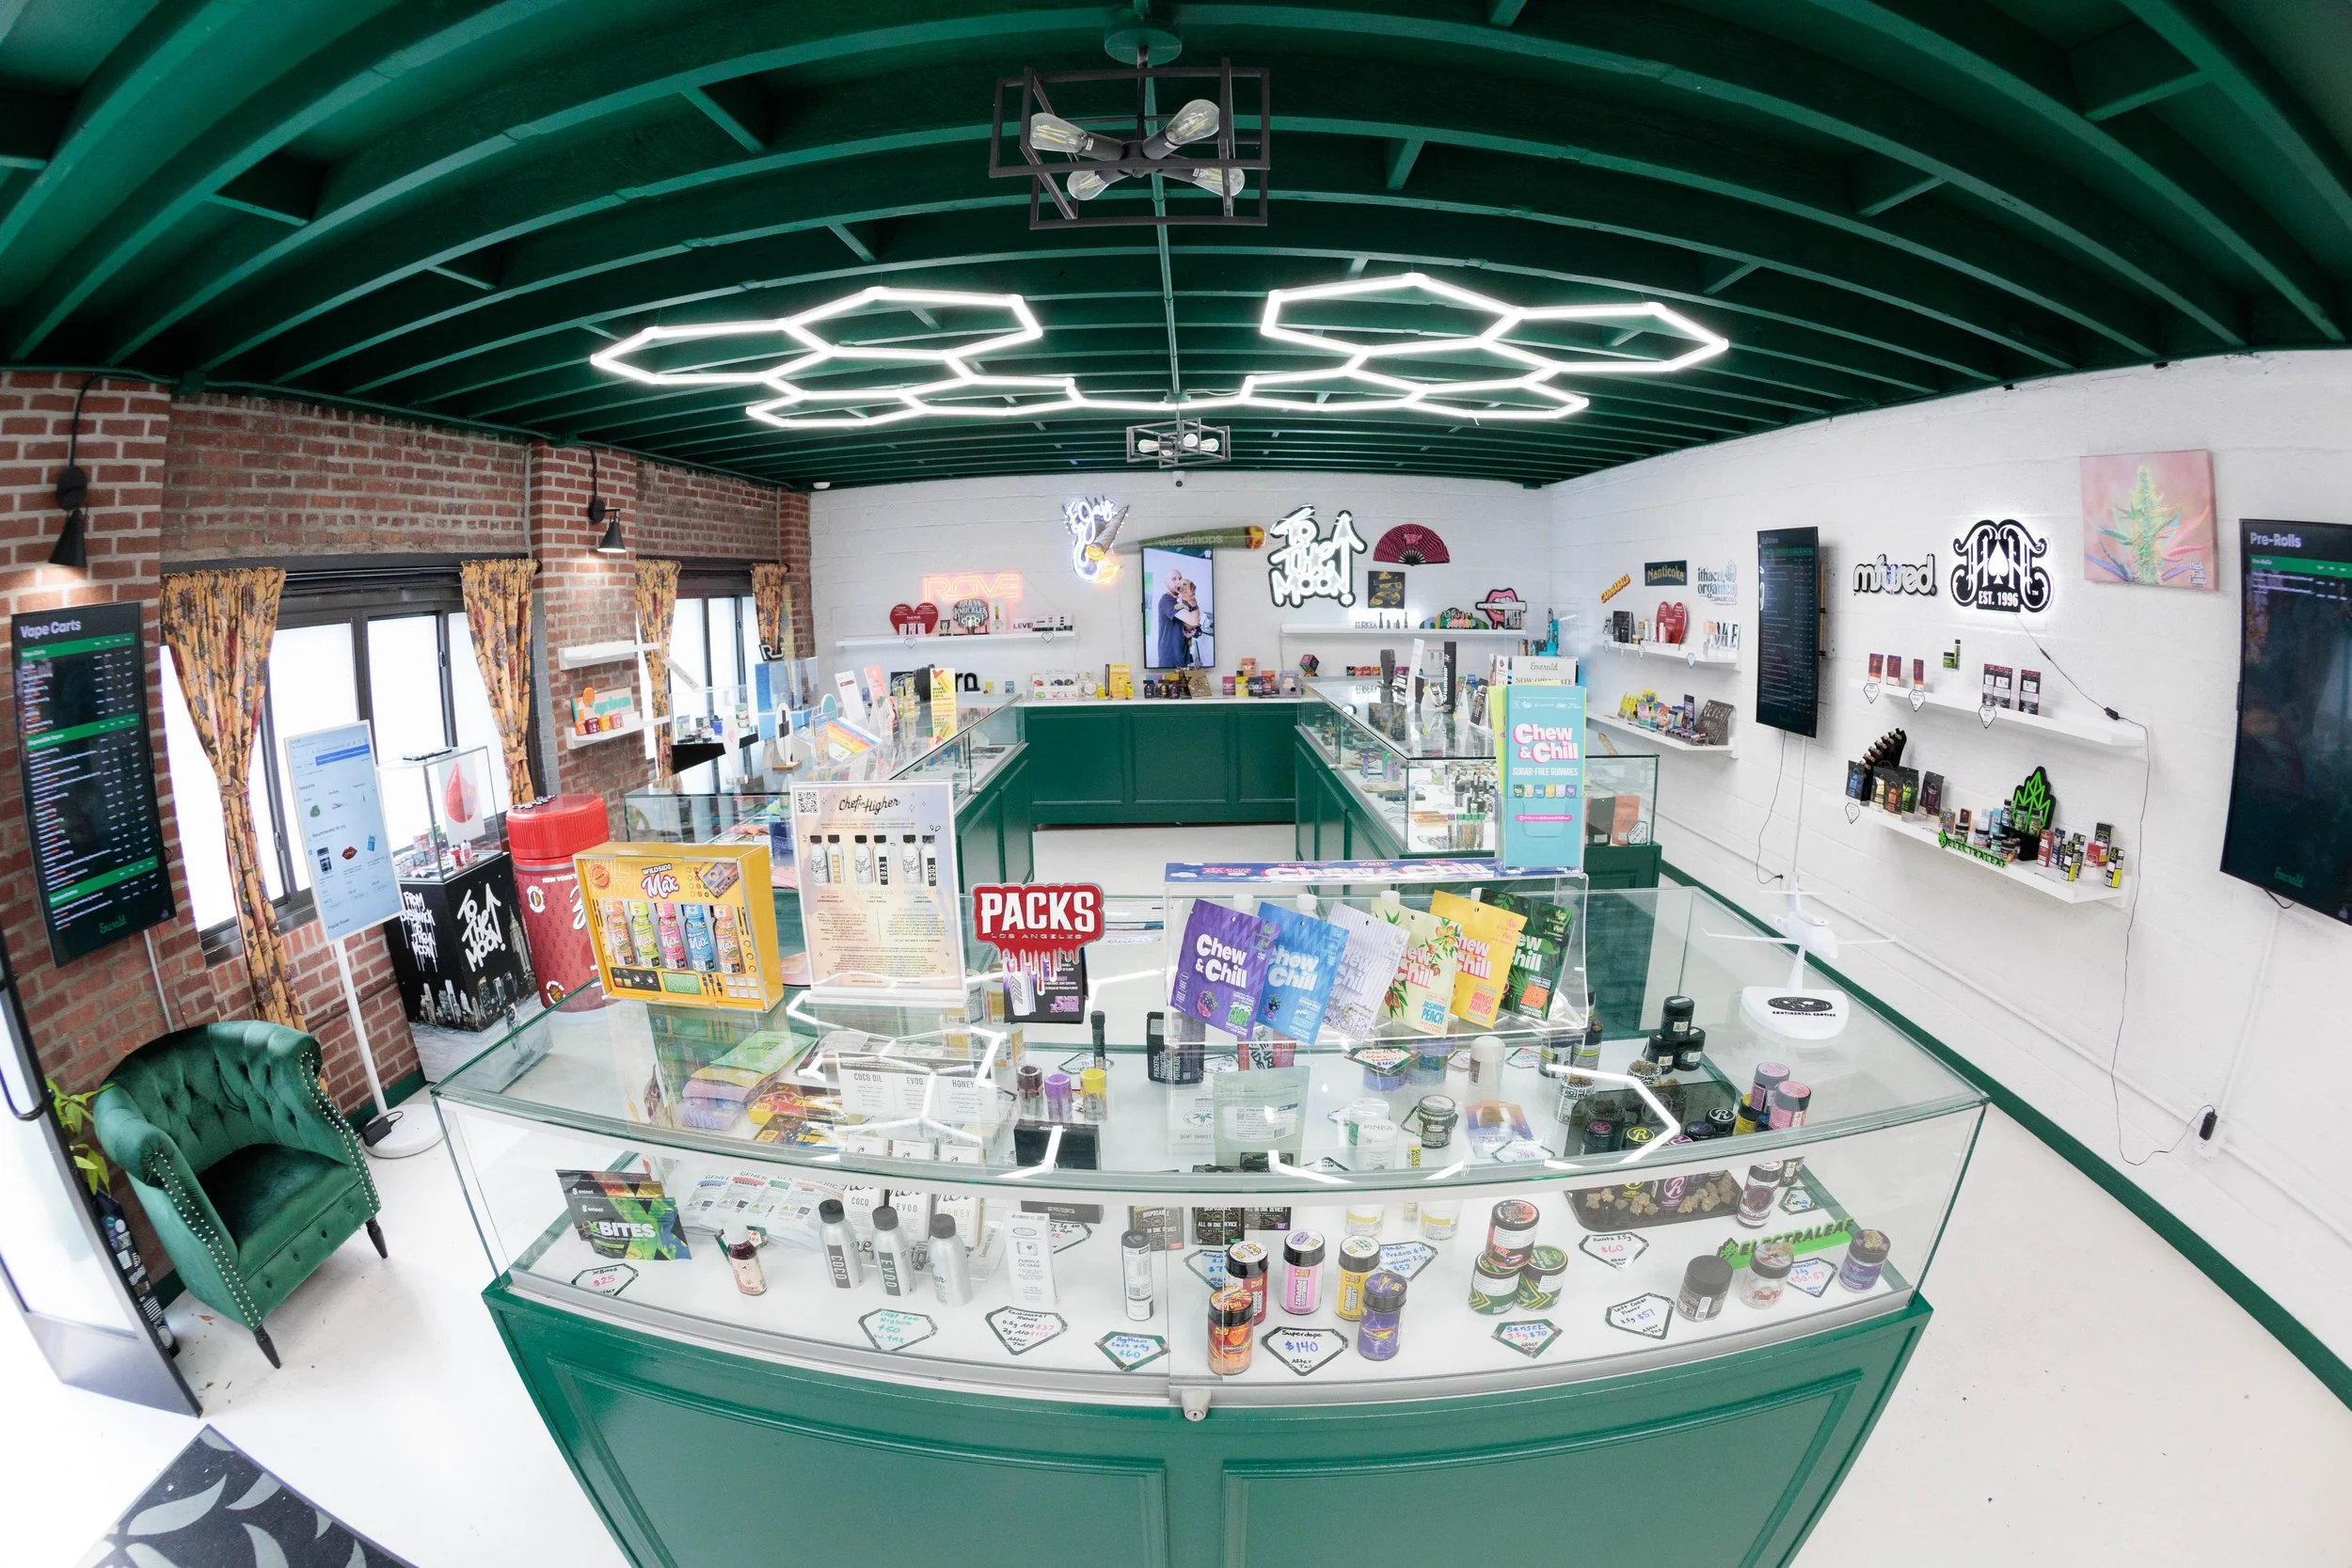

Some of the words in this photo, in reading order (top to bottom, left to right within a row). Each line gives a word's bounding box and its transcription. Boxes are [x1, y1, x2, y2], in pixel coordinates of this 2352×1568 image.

[1159, 534, 1223, 547] weedmaps
[2250, 531, 2302, 548] Pre-Rolls
[1647, 565, 1685, 582] Nanticoke
[923, 574, 1020, 600] ROVE
[1979, 590, 1994, 605] EST.
[1997, 592, 2019, 607] 1996
[20, 625, 49, 639] Vape
[51, 620, 82, 634] Carts
[1531, 661, 1558, 671] Emerald
[1704, 703, 1733, 722] REVERT
[1513, 723, 1573, 746] Chew
[1531, 742, 1579, 764] Chill
[1513, 768, 1549, 776] SUGAR-FREE
[1550, 768, 1579, 776] GUMMIES
[839, 795, 861, 811] Chef
[865, 796, 900, 816] Higher
[1947, 838, 2009, 870] ELECTRALEAF
[556, 874, 578, 882] YORK'
[642, 863, 673, 876] WILDSIDE
[641, 873, 680, 899] Max
[457, 889, 478, 923] TO
[980, 892, 1095, 934] PACKS
[1197, 933, 1248, 966] Chew
[1458, 935, 1490, 958] hew
[1518, 934, 1543, 952] ew
[1514, 948, 1543, 973] hill
[1195, 958, 1204, 974] &
[1205, 958, 1248, 989] Chill
[1268, 966, 1318, 991] Chill
[1422, 1000, 1446, 1013] JASMINE
[1471, 991, 1495, 1006] MANGO
[1421, 1007, 1443, 1025] PEACH
[1469, 1000, 1492, 1016] TANGO
[854, 1073, 870, 1082] COCO
[872, 1074, 883, 1083] OIL
[907, 1077, 923, 1085] EVOO
[952, 1080, 975, 1089] HONEY
[851, 1196, 869, 1207] COCO
[896, 1203, 917, 1212] EVOO
[831, 1255, 848, 1280] COCO
[881, 1259, 898, 1288] EVOO
[593, 1275, 615, 1287] $25
[1637, 1308, 1656, 1321] $57
[1002, 1320, 1018, 1328] 0.5g
[1282, 1329, 1323, 1338] Superdope
[1285, 1340, 1319, 1354] $140
